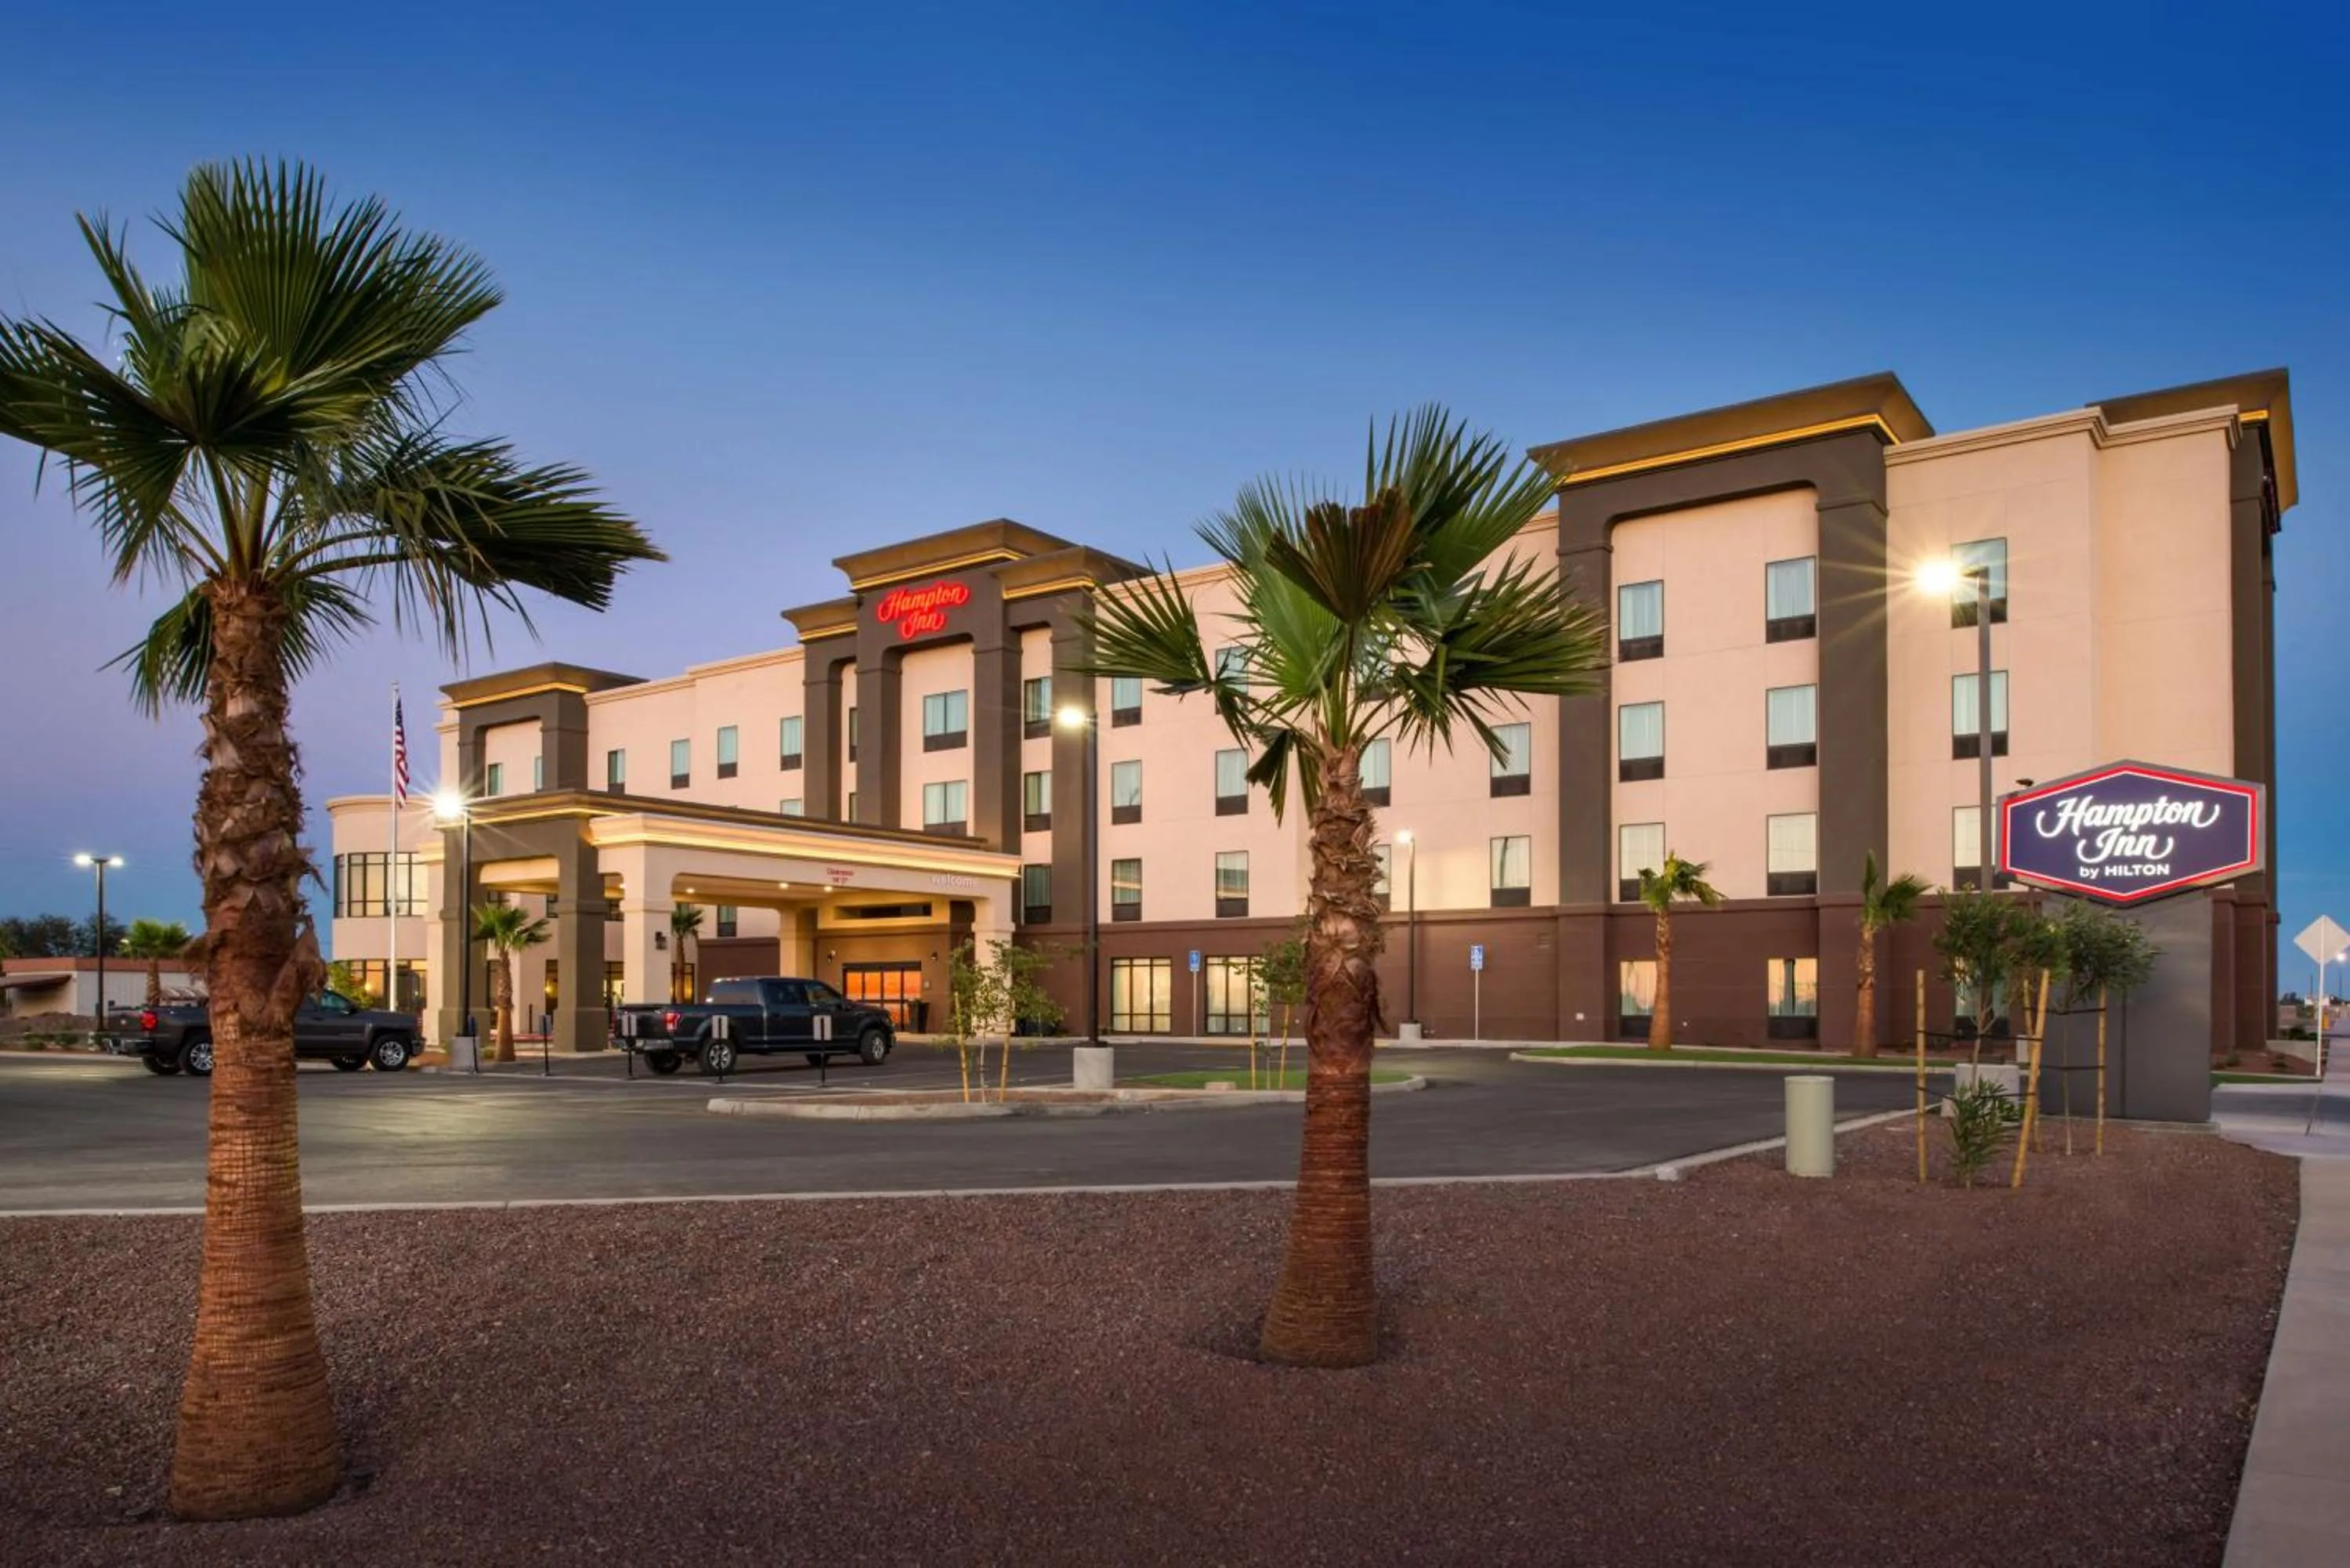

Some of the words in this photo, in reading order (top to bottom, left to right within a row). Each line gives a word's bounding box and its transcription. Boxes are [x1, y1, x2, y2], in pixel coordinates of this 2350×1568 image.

[877, 583, 968, 621] Hampton
[902, 610, 945, 638] Inn
[2036, 795, 2220, 837] Hampton
[2077, 826, 2174, 863] Inn
[930, 874, 978, 888] welcom
[2079, 866, 2099, 879] by
[2104, 864, 2170, 876] HILTON
